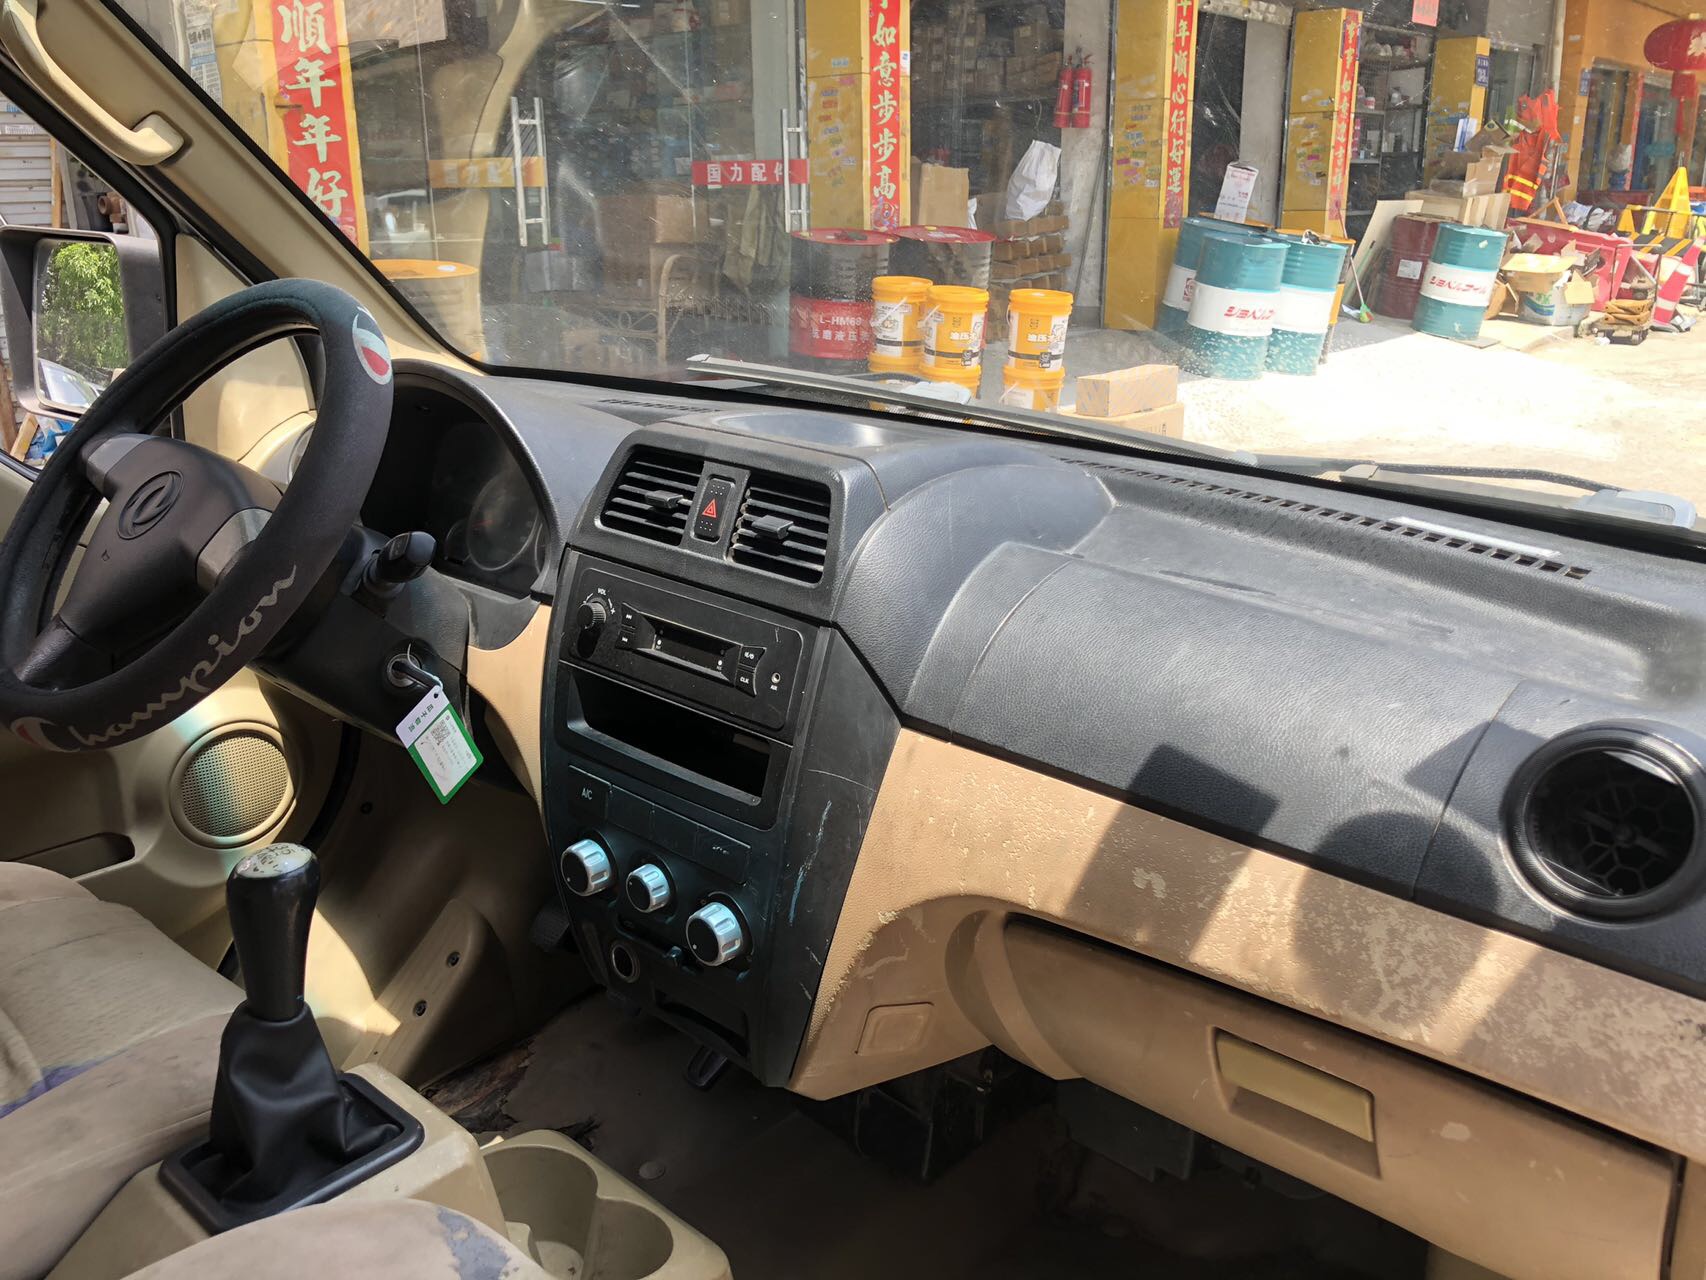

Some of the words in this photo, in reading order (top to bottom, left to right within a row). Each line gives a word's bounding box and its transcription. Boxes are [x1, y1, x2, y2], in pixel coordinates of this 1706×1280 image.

[872, 0, 897, 199] 如意步步高
[10, 564, 297, 752] Champion
[581, 787, 593, 800] A/C
